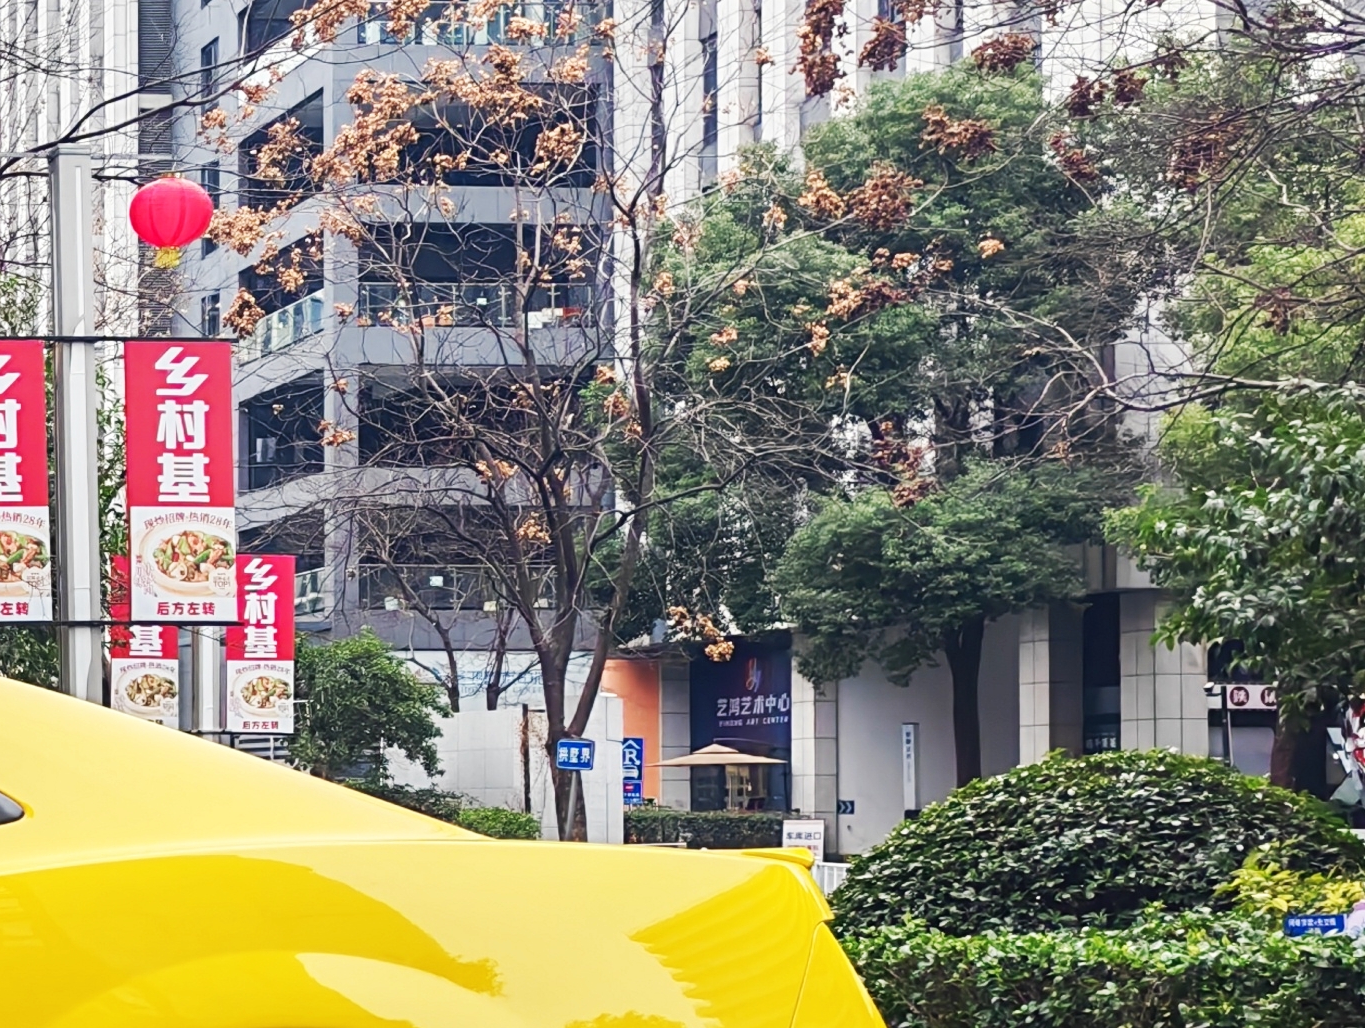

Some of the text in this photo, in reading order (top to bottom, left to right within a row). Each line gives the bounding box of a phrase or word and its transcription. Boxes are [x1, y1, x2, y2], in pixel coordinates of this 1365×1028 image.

[154, 346, 211, 503] 乡村基
[156, 601, 216, 616] 后方左转
[243, 557, 278, 659] 乡村基
[716, 692, 790, 717] 艺鸿艺术中心
